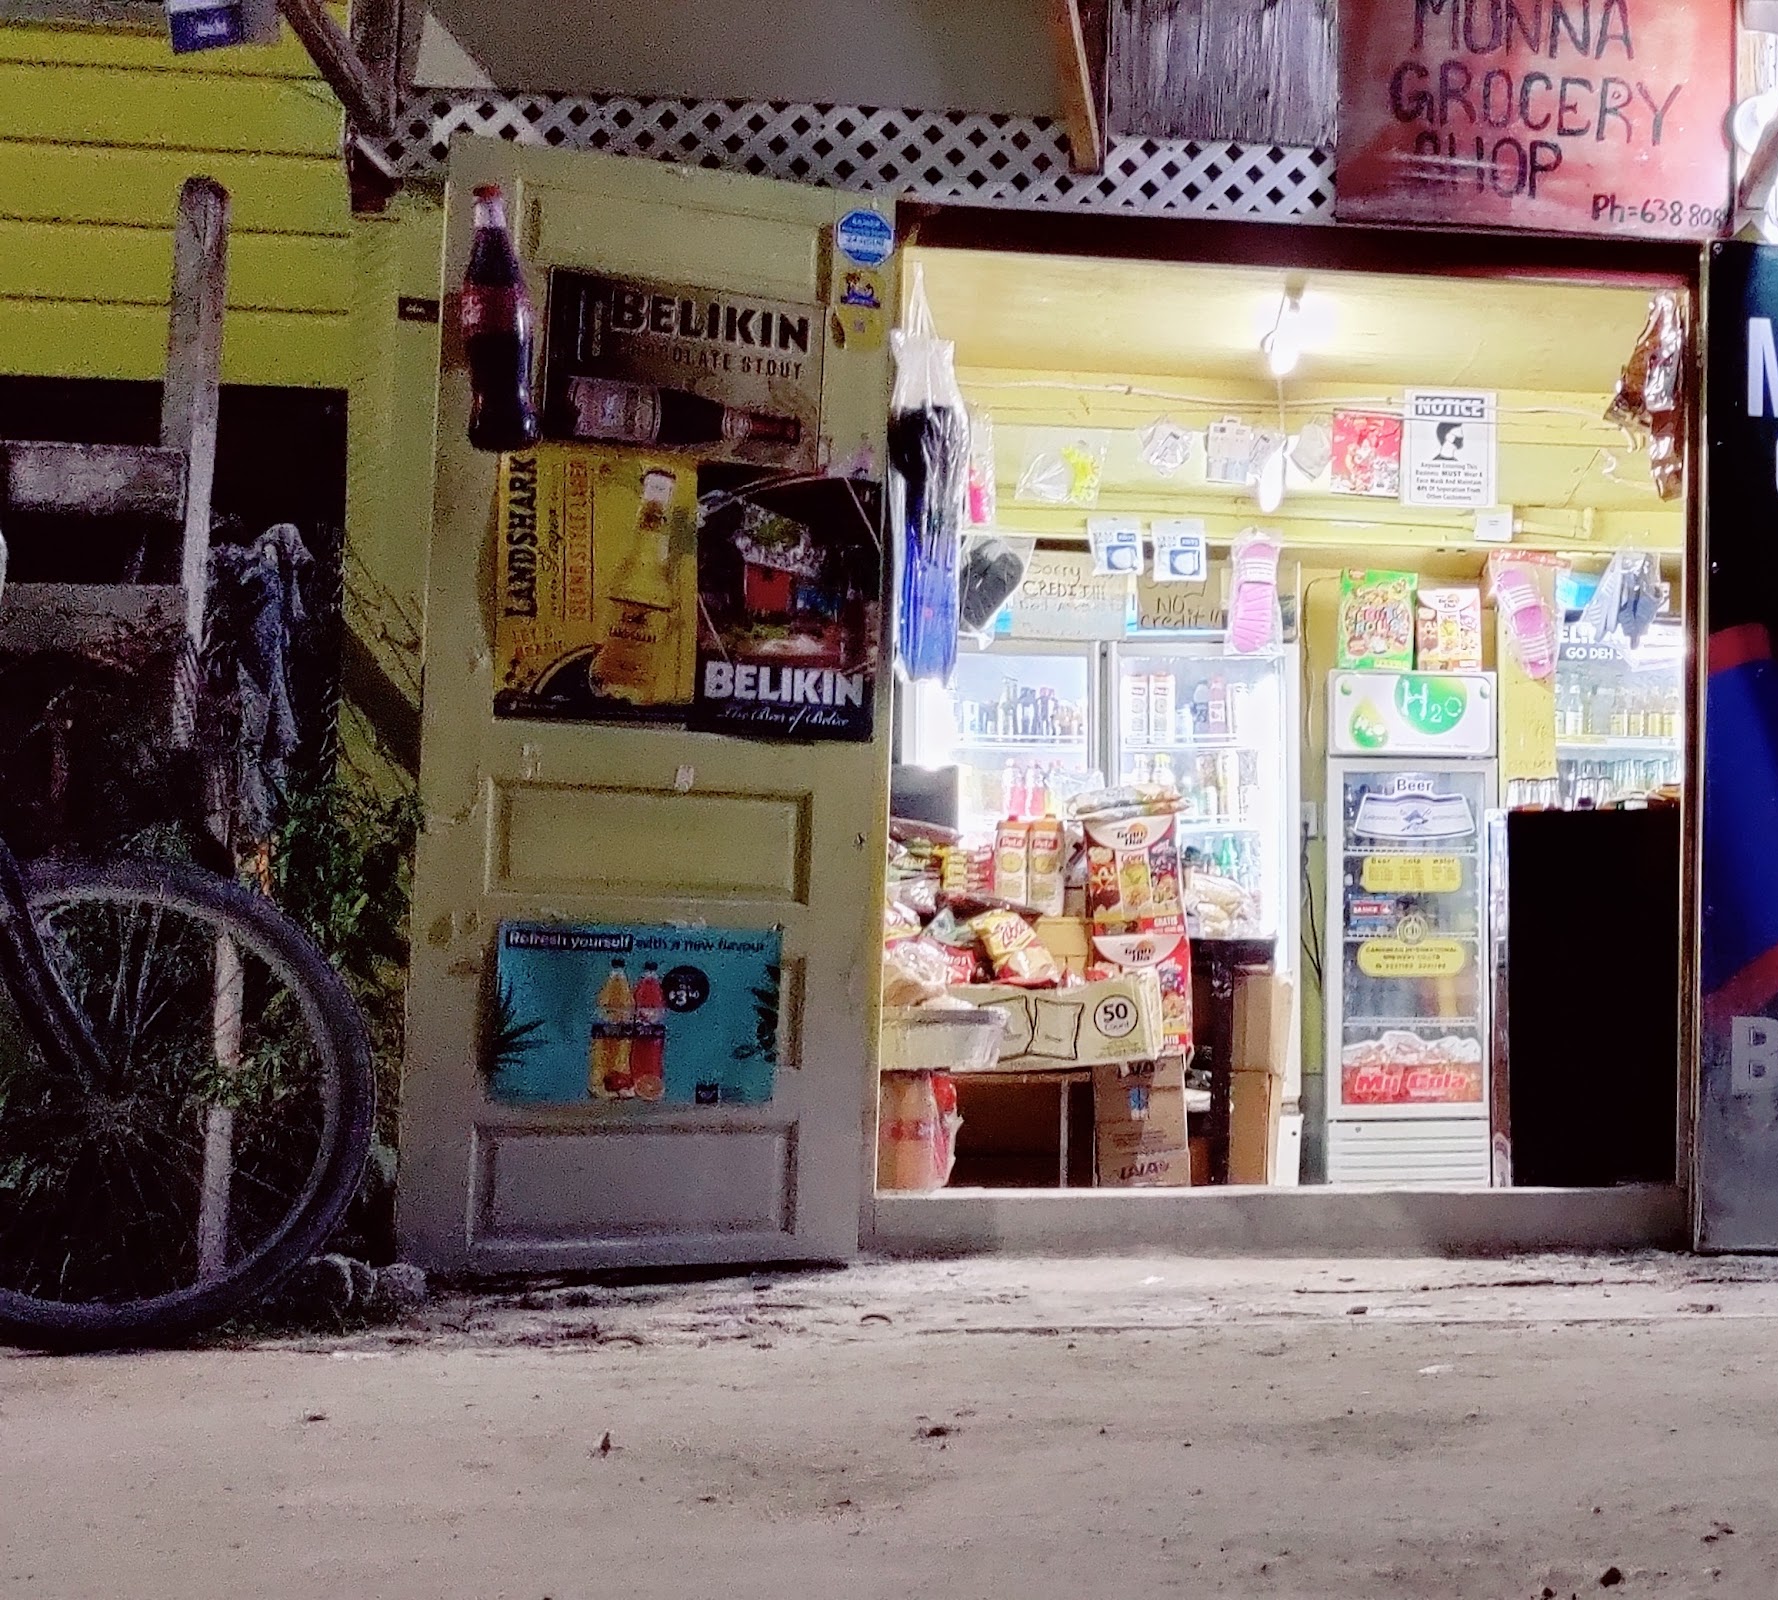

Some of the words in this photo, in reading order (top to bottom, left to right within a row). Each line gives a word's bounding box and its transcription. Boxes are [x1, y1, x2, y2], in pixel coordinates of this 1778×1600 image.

[1410, 0, 1635, 60] MUNNA
[1389, 60, 1683, 146] GROCERY
[1415, 131, 1563, 200] SHOP
[611, 288, 811, 354] BELIKIN
[742, 358, 803, 380] STOUT
[1416, 397, 1482, 417] NOTICE
[505, 455, 539, 619] LANDSHARK
[1028, 561, 1081, 586] Sorry
[1156, 595, 1185, 614] NO
[1141, 608, 1205, 629] credit
[1566, 647, 1587, 660] GO
[1589, 648, 1614, 660] DEH
[704, 660, 864, 708] BELIKIN
[1396, 778, 1433, 791] Beer
[508, 931, 567, 947] Refresh
[571, 934, 632, 950] yourself
[1103, 1002, 1128, 1023] 50
